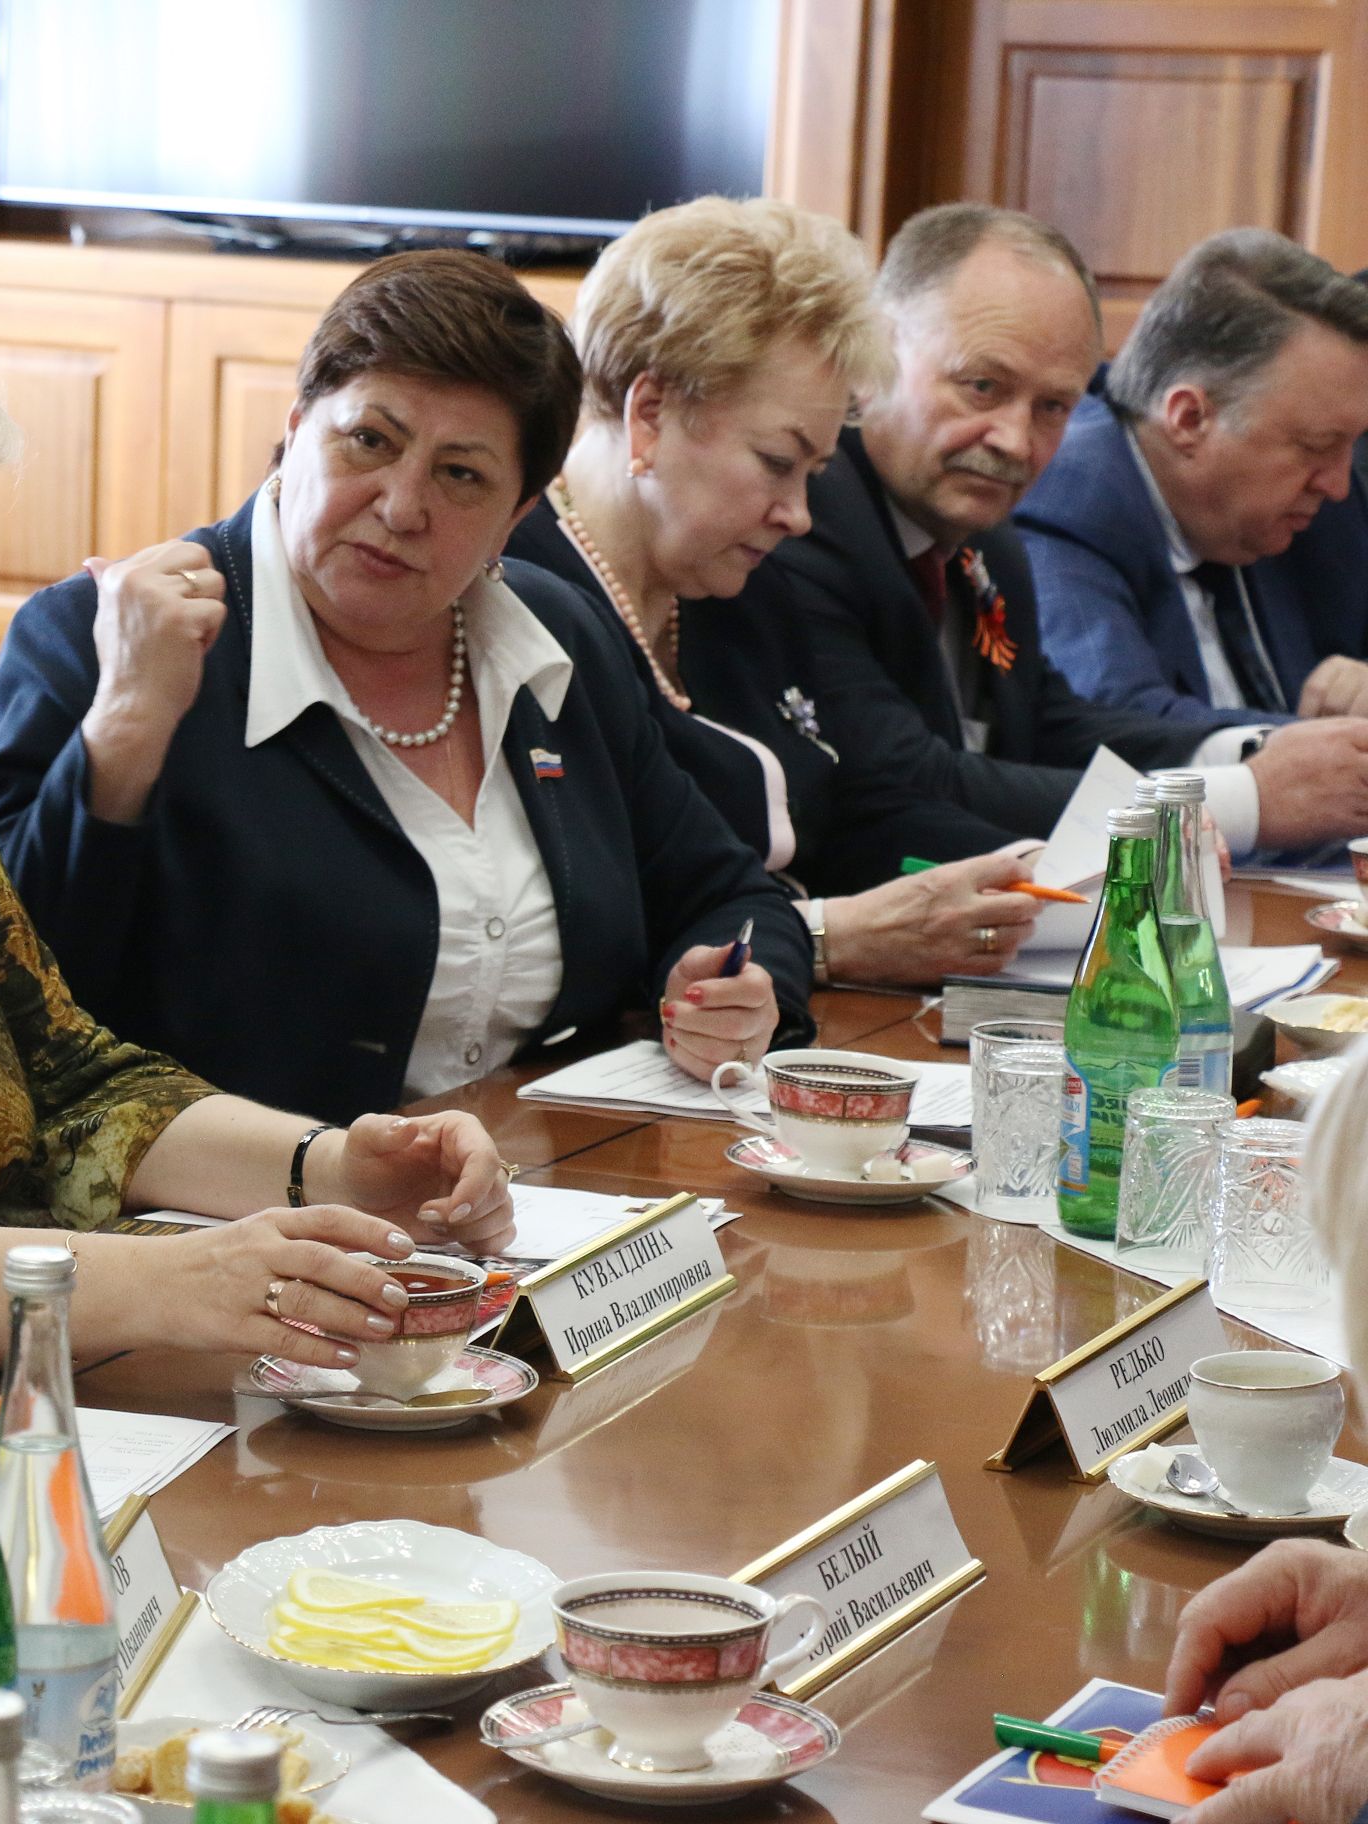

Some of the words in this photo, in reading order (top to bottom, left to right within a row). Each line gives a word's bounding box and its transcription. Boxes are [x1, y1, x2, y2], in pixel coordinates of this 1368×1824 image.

[570, 1228, 673, 1300] КУВАЛДИНА
[562, 1313, 614, 1356] Ирина
[609, 1259, 712, 1329] Владимировна
[1109, 1335, 1165, 1390] РЕДЬКО
[1090, 1404, 1150, 1455] Людмила
[817, 1523, 884, 1592] БЕЛЫЙ
[847, 1559, 936, 1630] Васильевич
